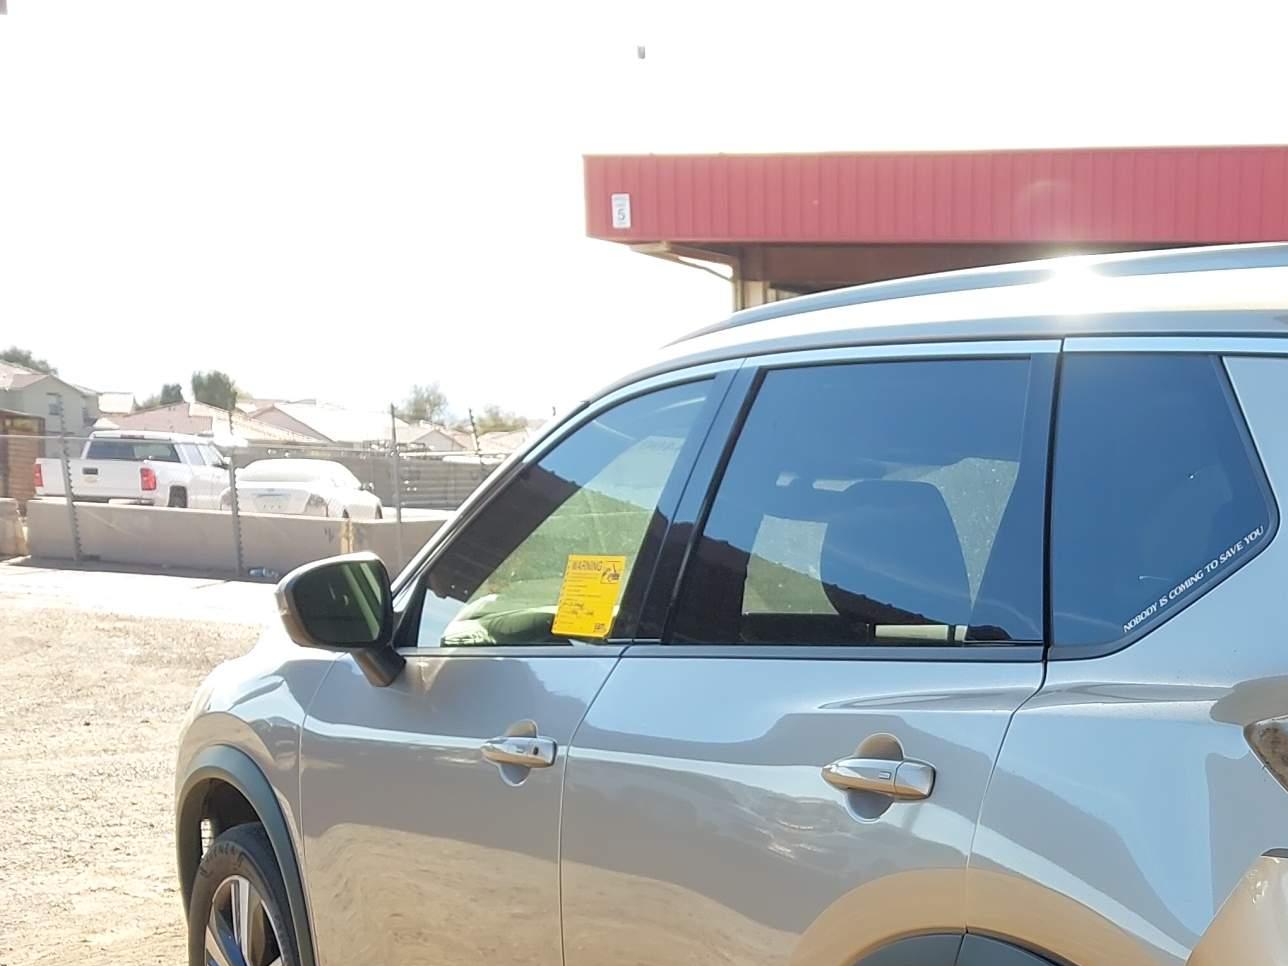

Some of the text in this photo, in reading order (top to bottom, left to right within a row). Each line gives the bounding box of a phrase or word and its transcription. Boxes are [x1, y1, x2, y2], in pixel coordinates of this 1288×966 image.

[1123, 526, 1264, 633] NOBODY IS COMING TO SAVE YOU
